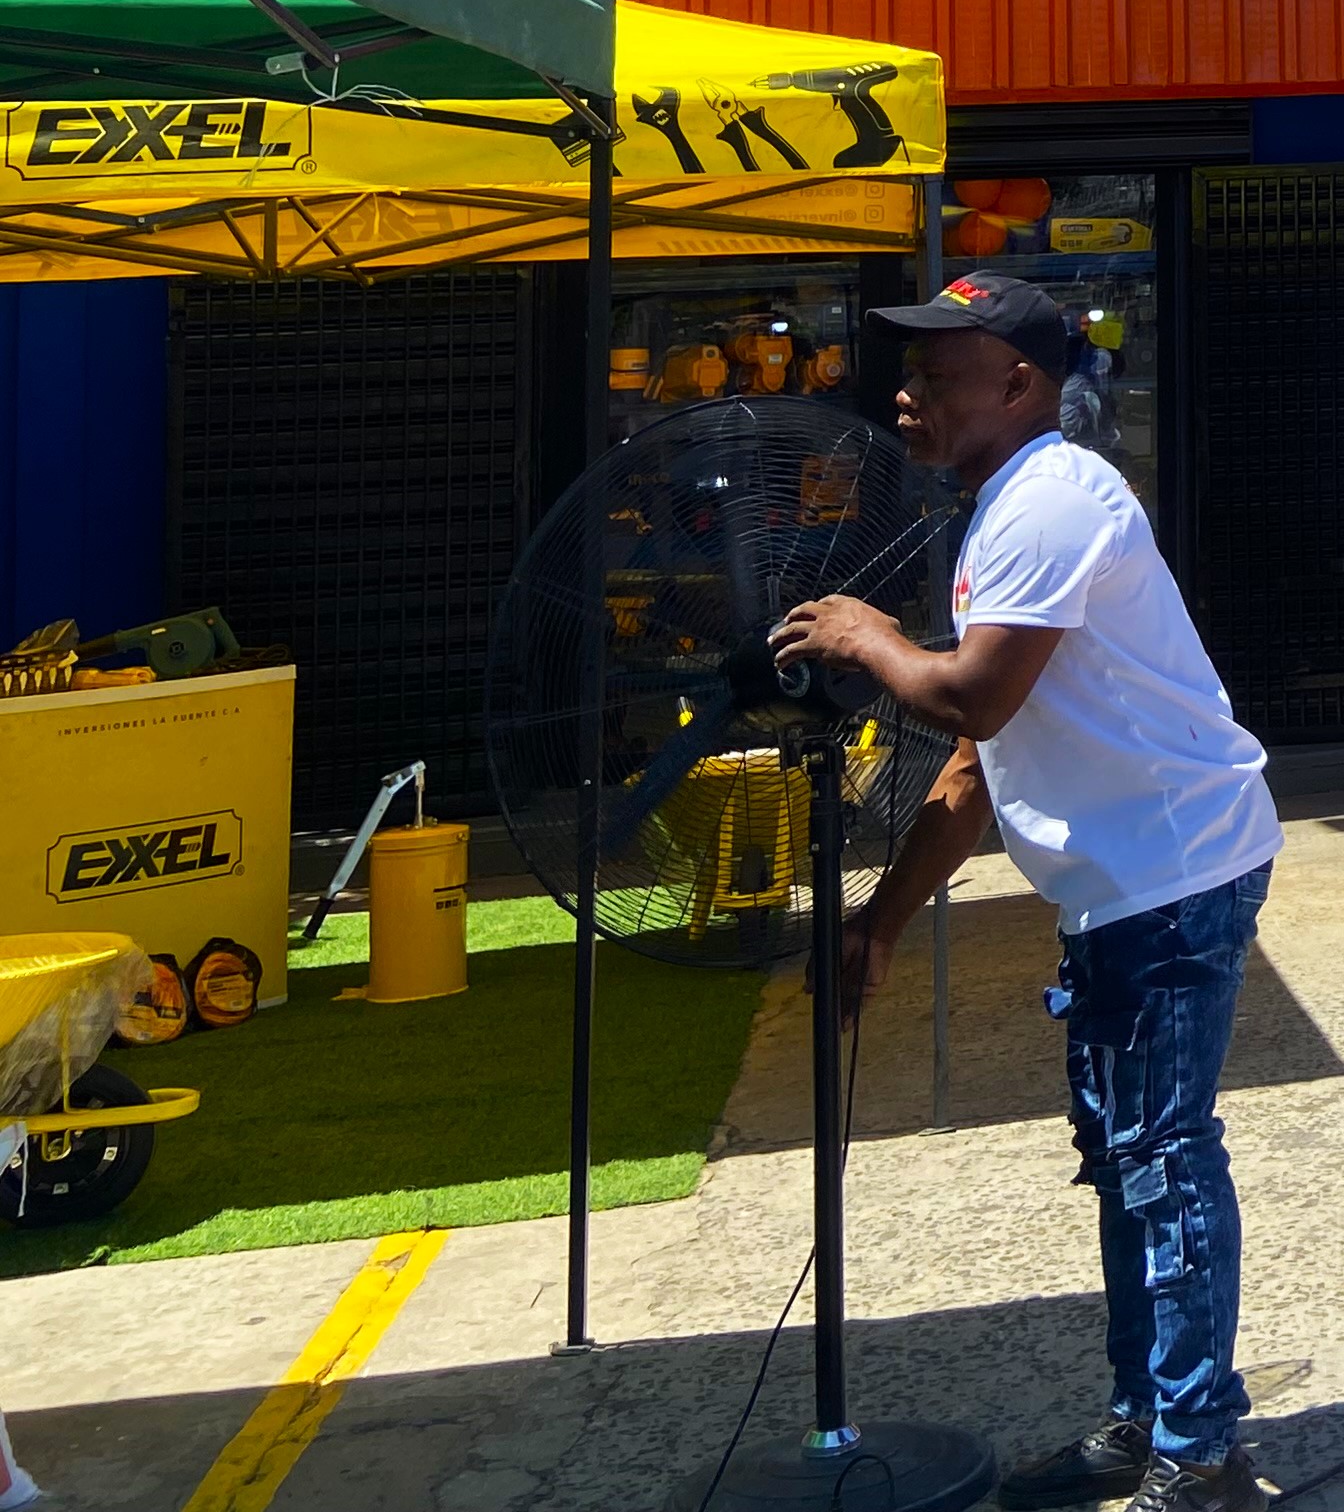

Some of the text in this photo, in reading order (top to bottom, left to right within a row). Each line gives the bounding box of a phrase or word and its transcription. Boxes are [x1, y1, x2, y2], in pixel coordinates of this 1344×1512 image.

[26, 101, 292, 166] EXXEL
[57, 719, 146, 737] INVERSIONES
[152, 716, 167, 725] LA
[172, 710, 217, 723] FUENTE
[60, 822, 232, 893] EXXEL
